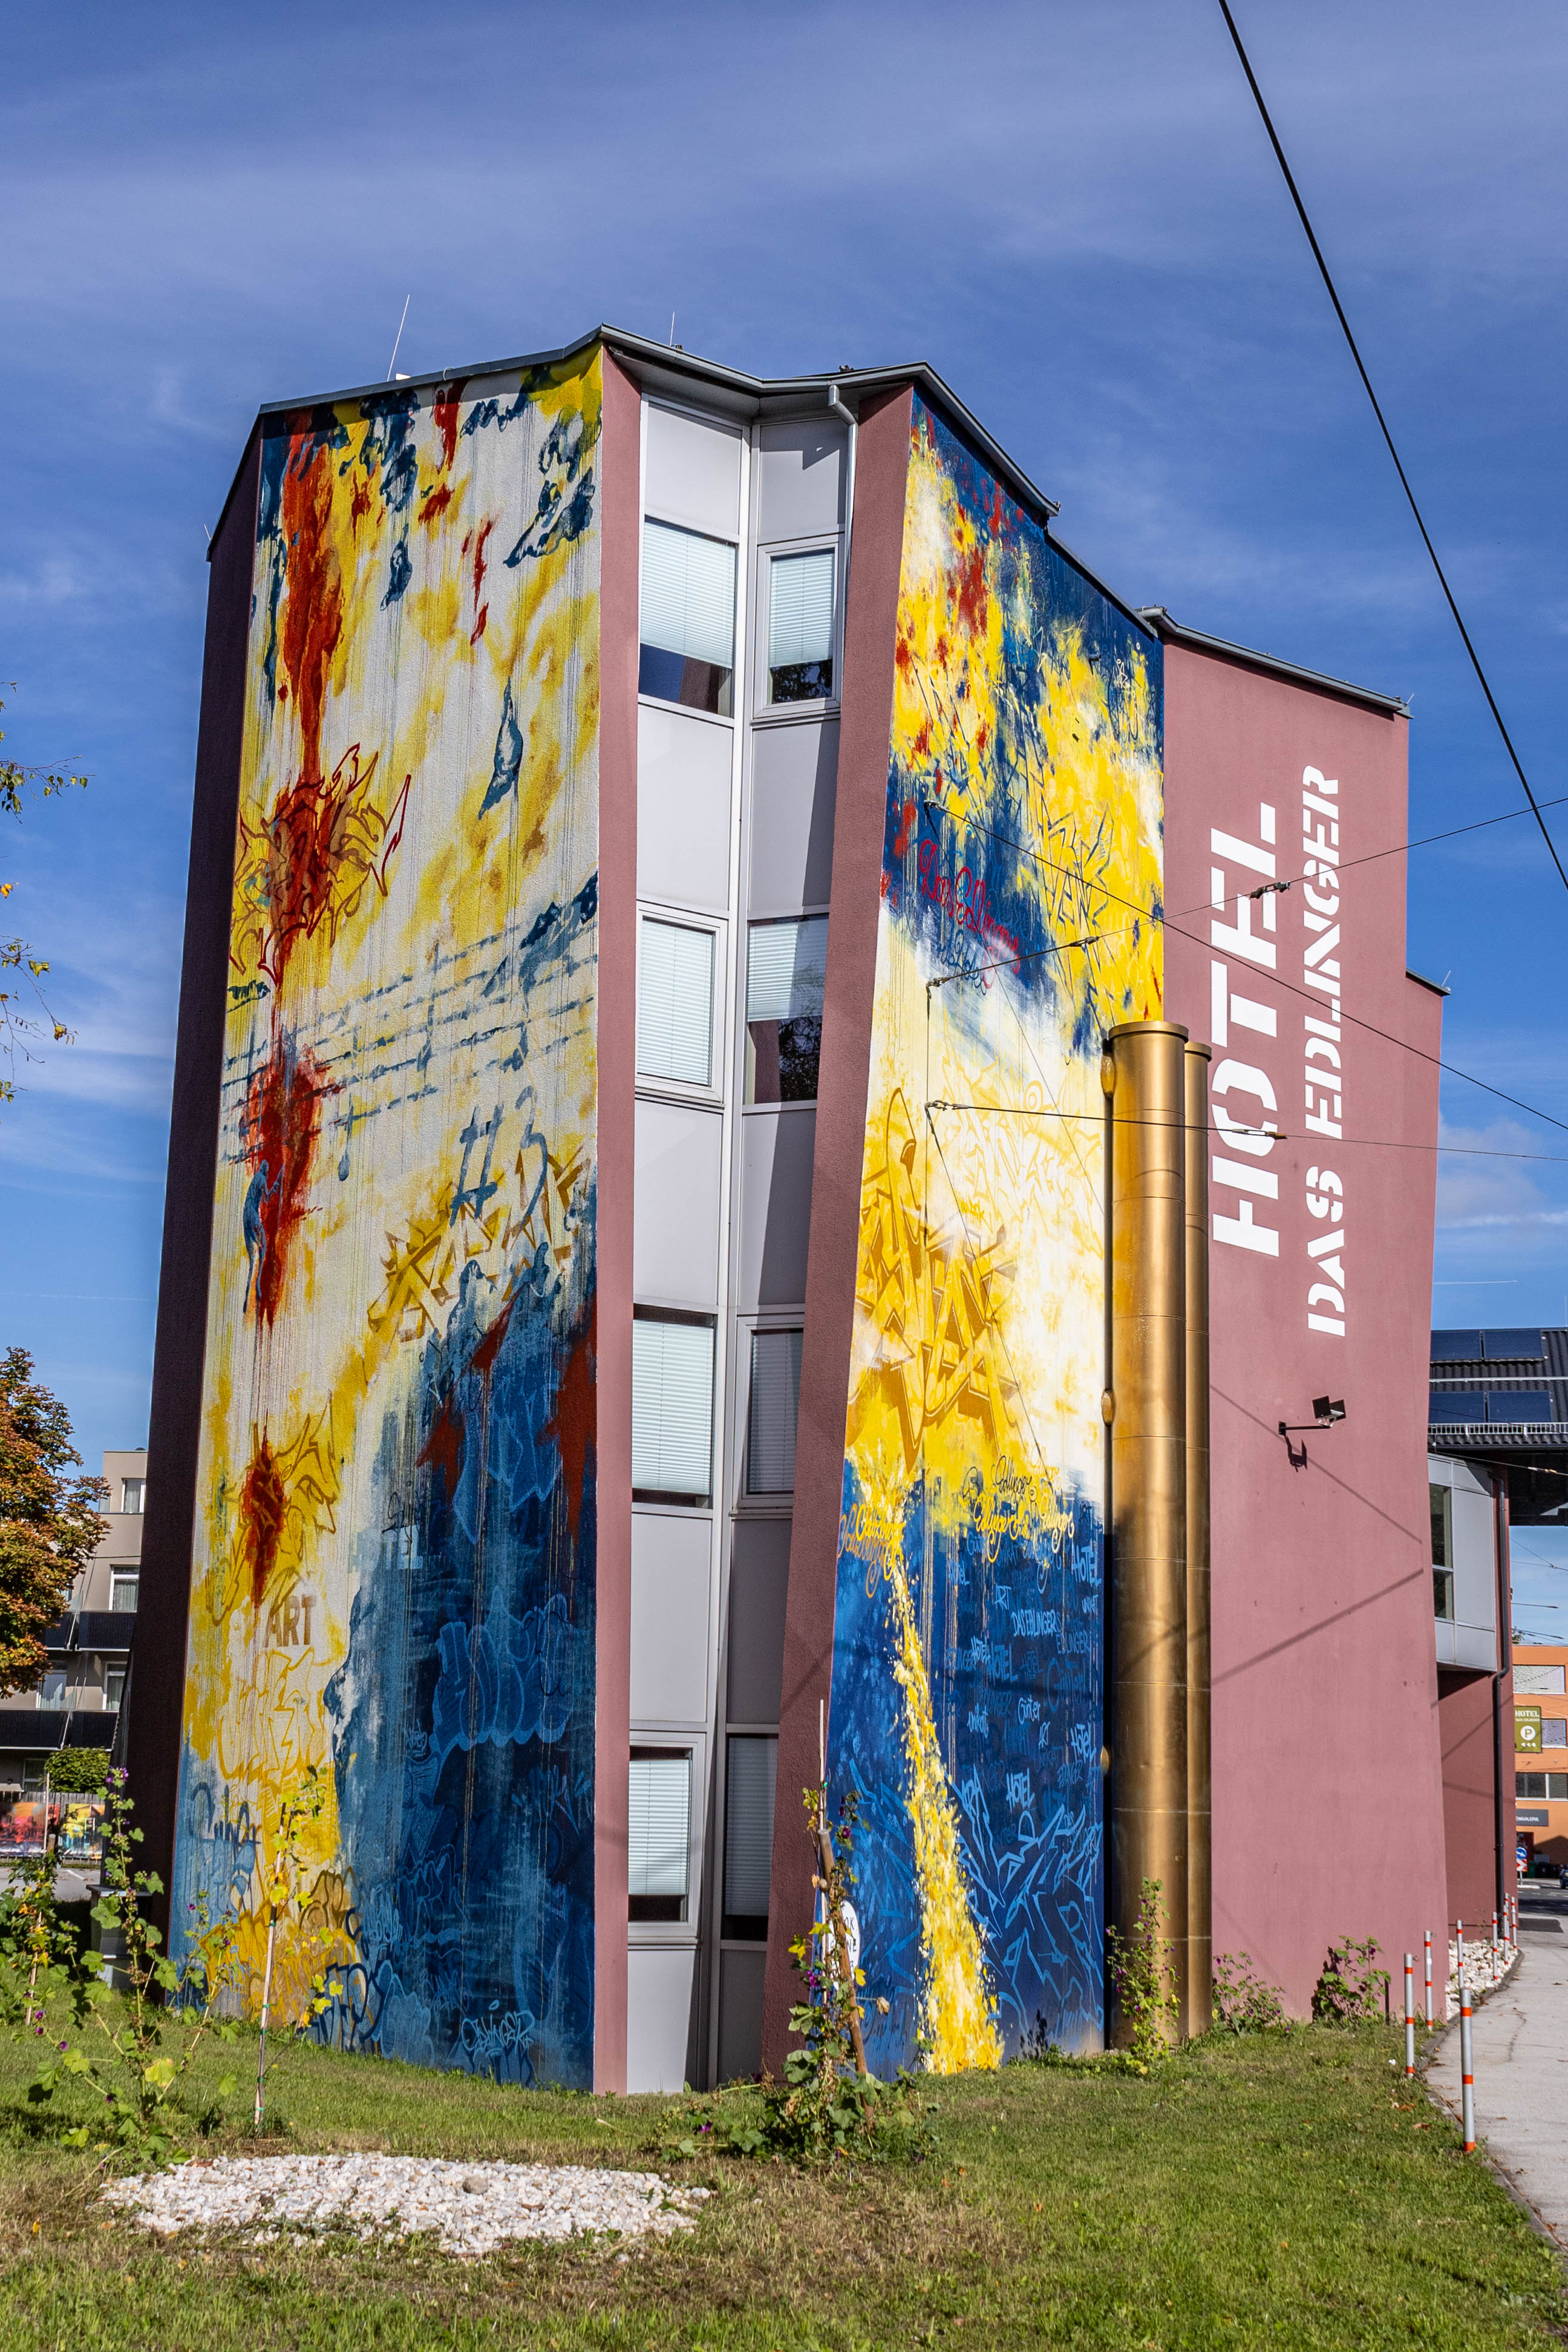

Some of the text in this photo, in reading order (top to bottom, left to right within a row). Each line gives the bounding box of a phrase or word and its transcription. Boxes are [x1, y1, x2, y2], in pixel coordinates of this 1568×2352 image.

[1211, 803, 1279, 1256] HOTEL
[1303, 766, 1345, 1336] DAS EDLINGER
[264, 1595, 315, 1648] ART
